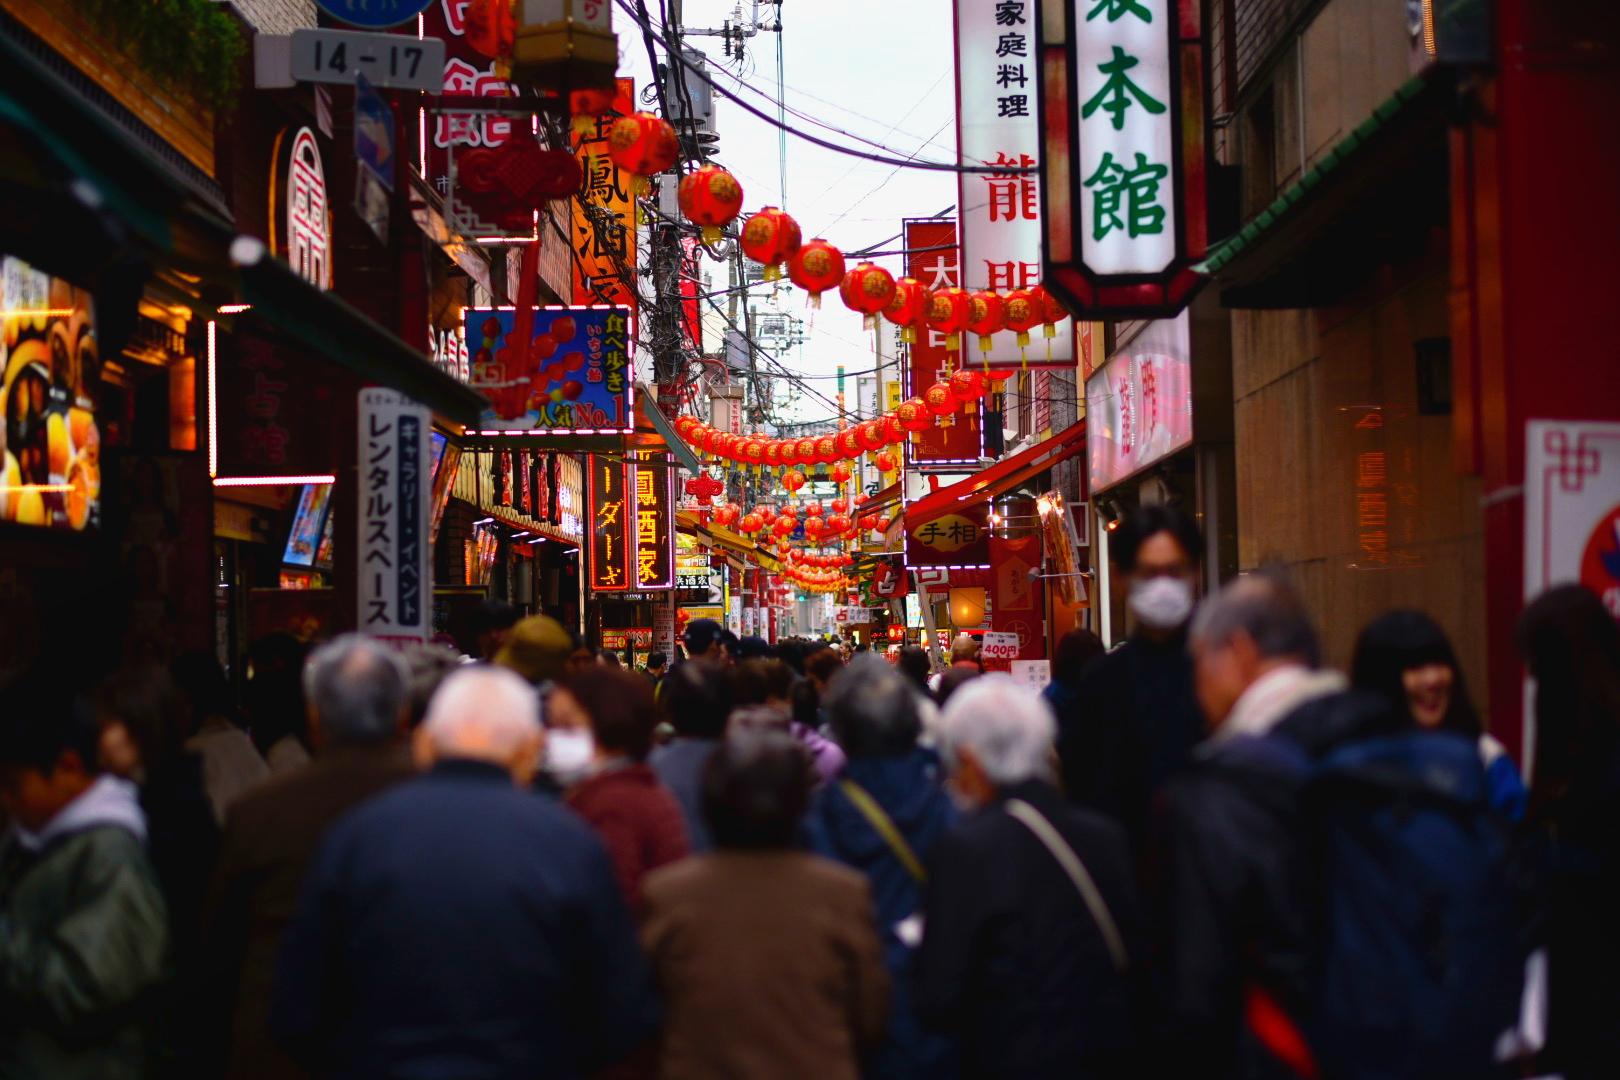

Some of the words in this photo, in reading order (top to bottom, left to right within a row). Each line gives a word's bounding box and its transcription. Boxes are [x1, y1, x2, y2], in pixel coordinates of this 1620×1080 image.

[314, 40, 424, 79] 14-17
[995, 0, 1030, 118] 家庭料理
[586, 324, 603, 384] いちご飴
[604, 312, 626, 393] 食べ歩き
[365, 413, 393, 625] レンタルスペース
[918, 522, 977, 545] 手相
[878, 570, 899, 594] 占
[984, 644, 1017, 655] 400円
